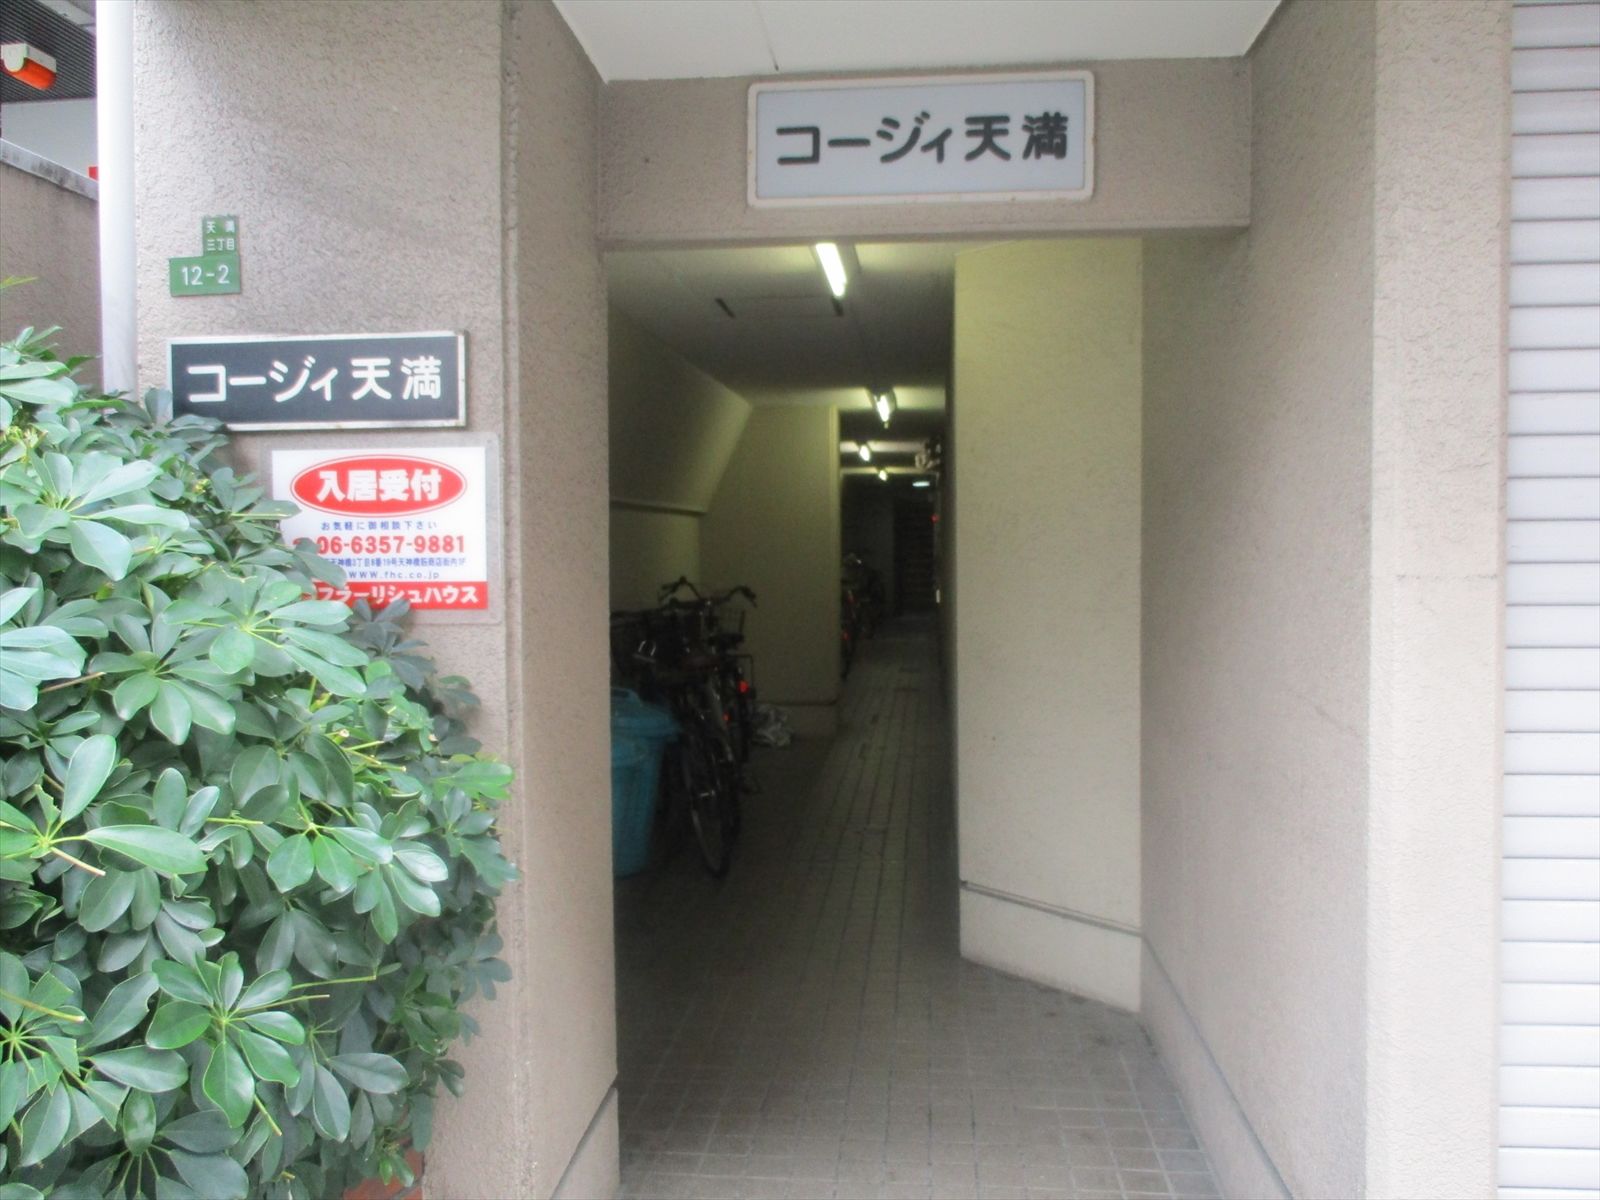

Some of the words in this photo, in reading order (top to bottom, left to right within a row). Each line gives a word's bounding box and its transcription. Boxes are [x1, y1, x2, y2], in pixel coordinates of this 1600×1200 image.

[776, 111, 1069, 166] コージィ天満
[206, 238, 235, 251] 三丁目
[181, 264, 231, 286] 12-2
[187, 355, 442, 403] コージィ天満
[316, 468, 442, 502] 入居受付
[316, 535, 465, 555] 06-6357-9881
